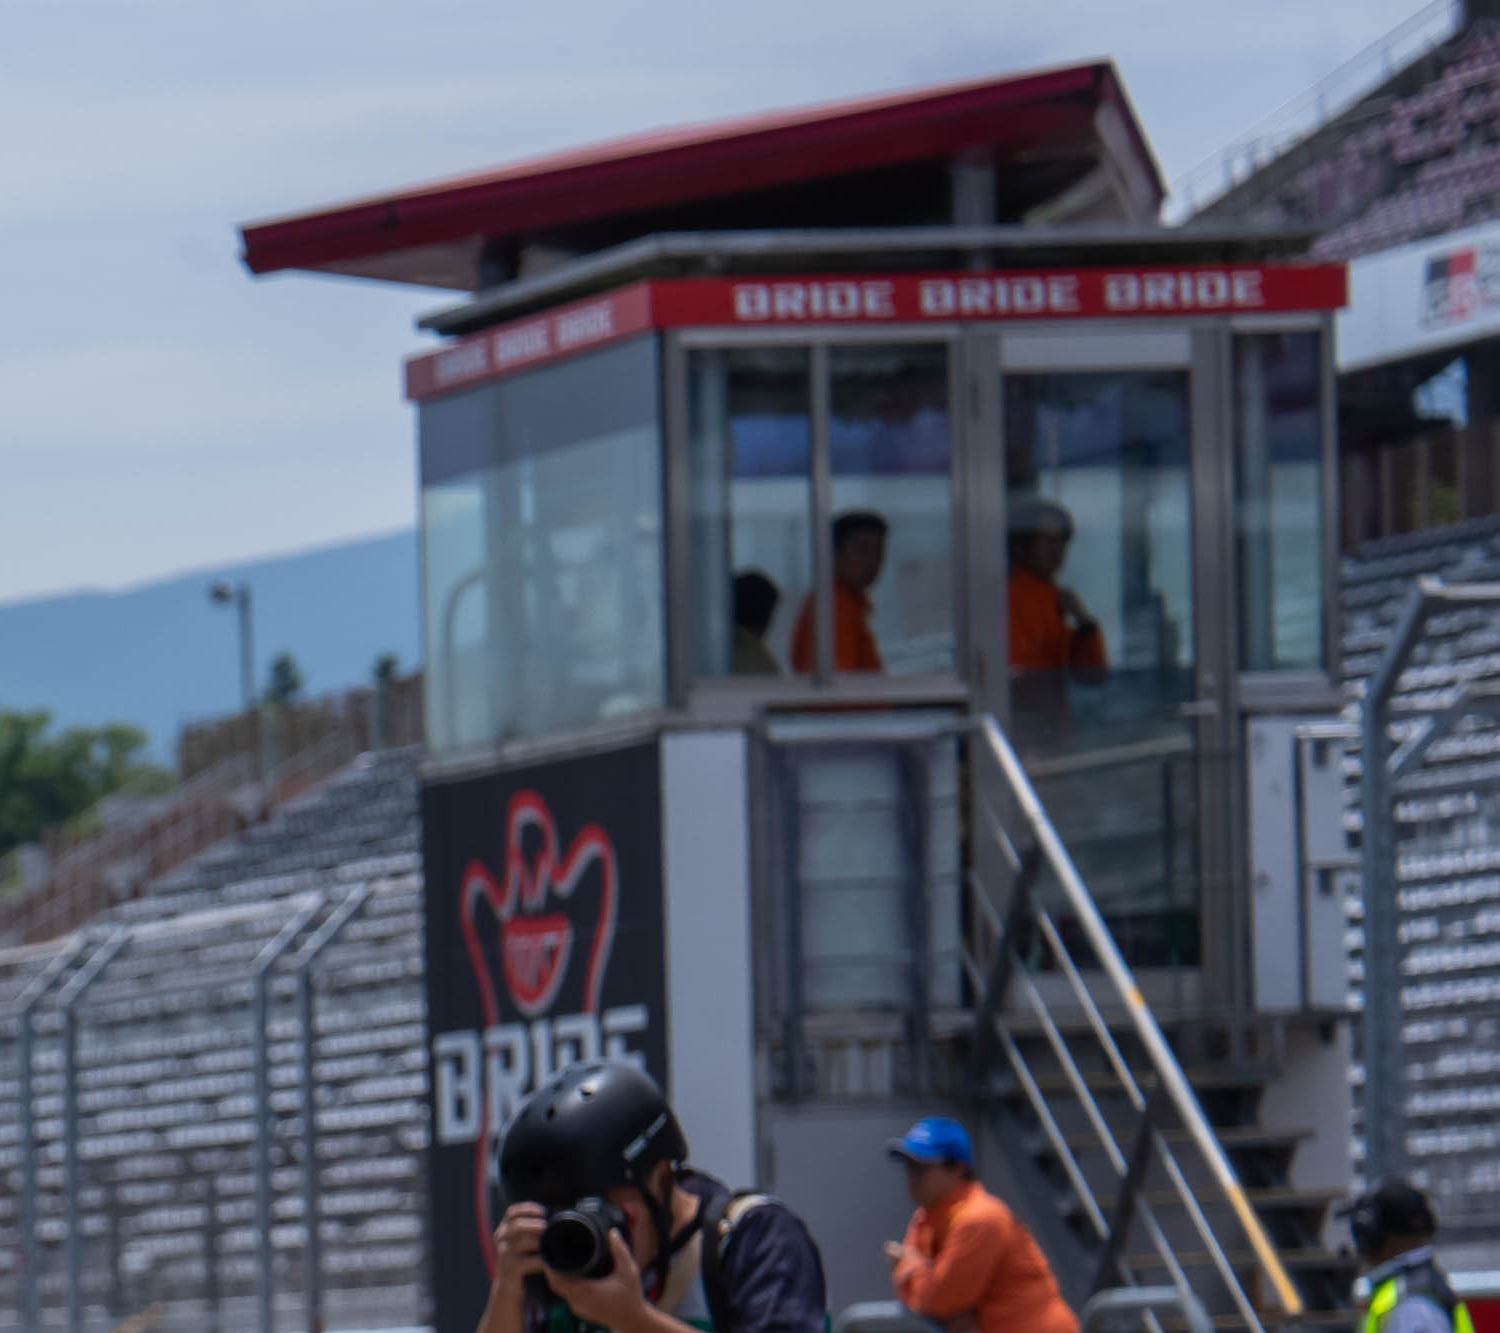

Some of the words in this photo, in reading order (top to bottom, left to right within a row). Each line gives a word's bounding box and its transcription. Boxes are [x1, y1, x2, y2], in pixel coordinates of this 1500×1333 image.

[733, 282, 896, 321] BRIDE
[918, 275, 1081, 316] BRIDE
[1103, 271, 1266, 310] BRIDE
